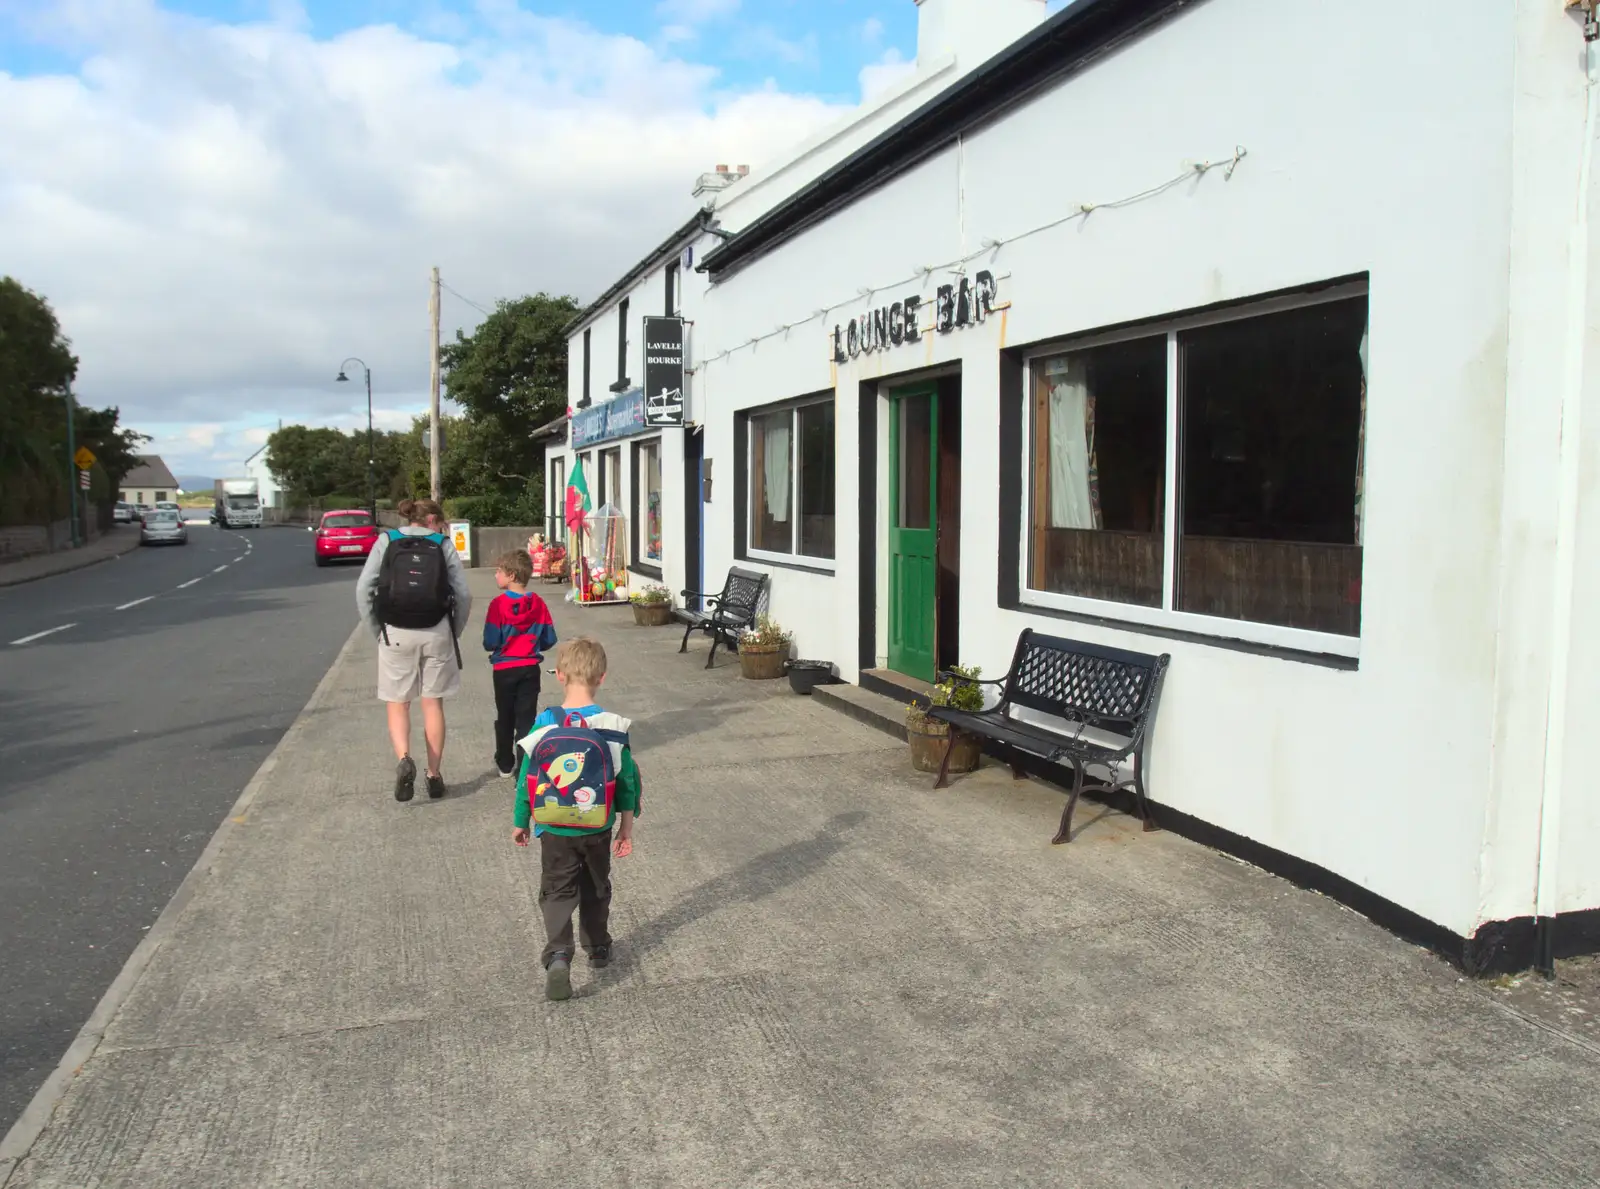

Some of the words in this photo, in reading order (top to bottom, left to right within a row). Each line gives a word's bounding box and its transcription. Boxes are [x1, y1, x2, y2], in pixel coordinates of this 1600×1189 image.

[834, 295, 921, 363] LOUNGE
[937, 270, 997, 333] BAR
[647, 342, 682, 350] LAVELLE
[647, 356, 682, 365] BOURKE
